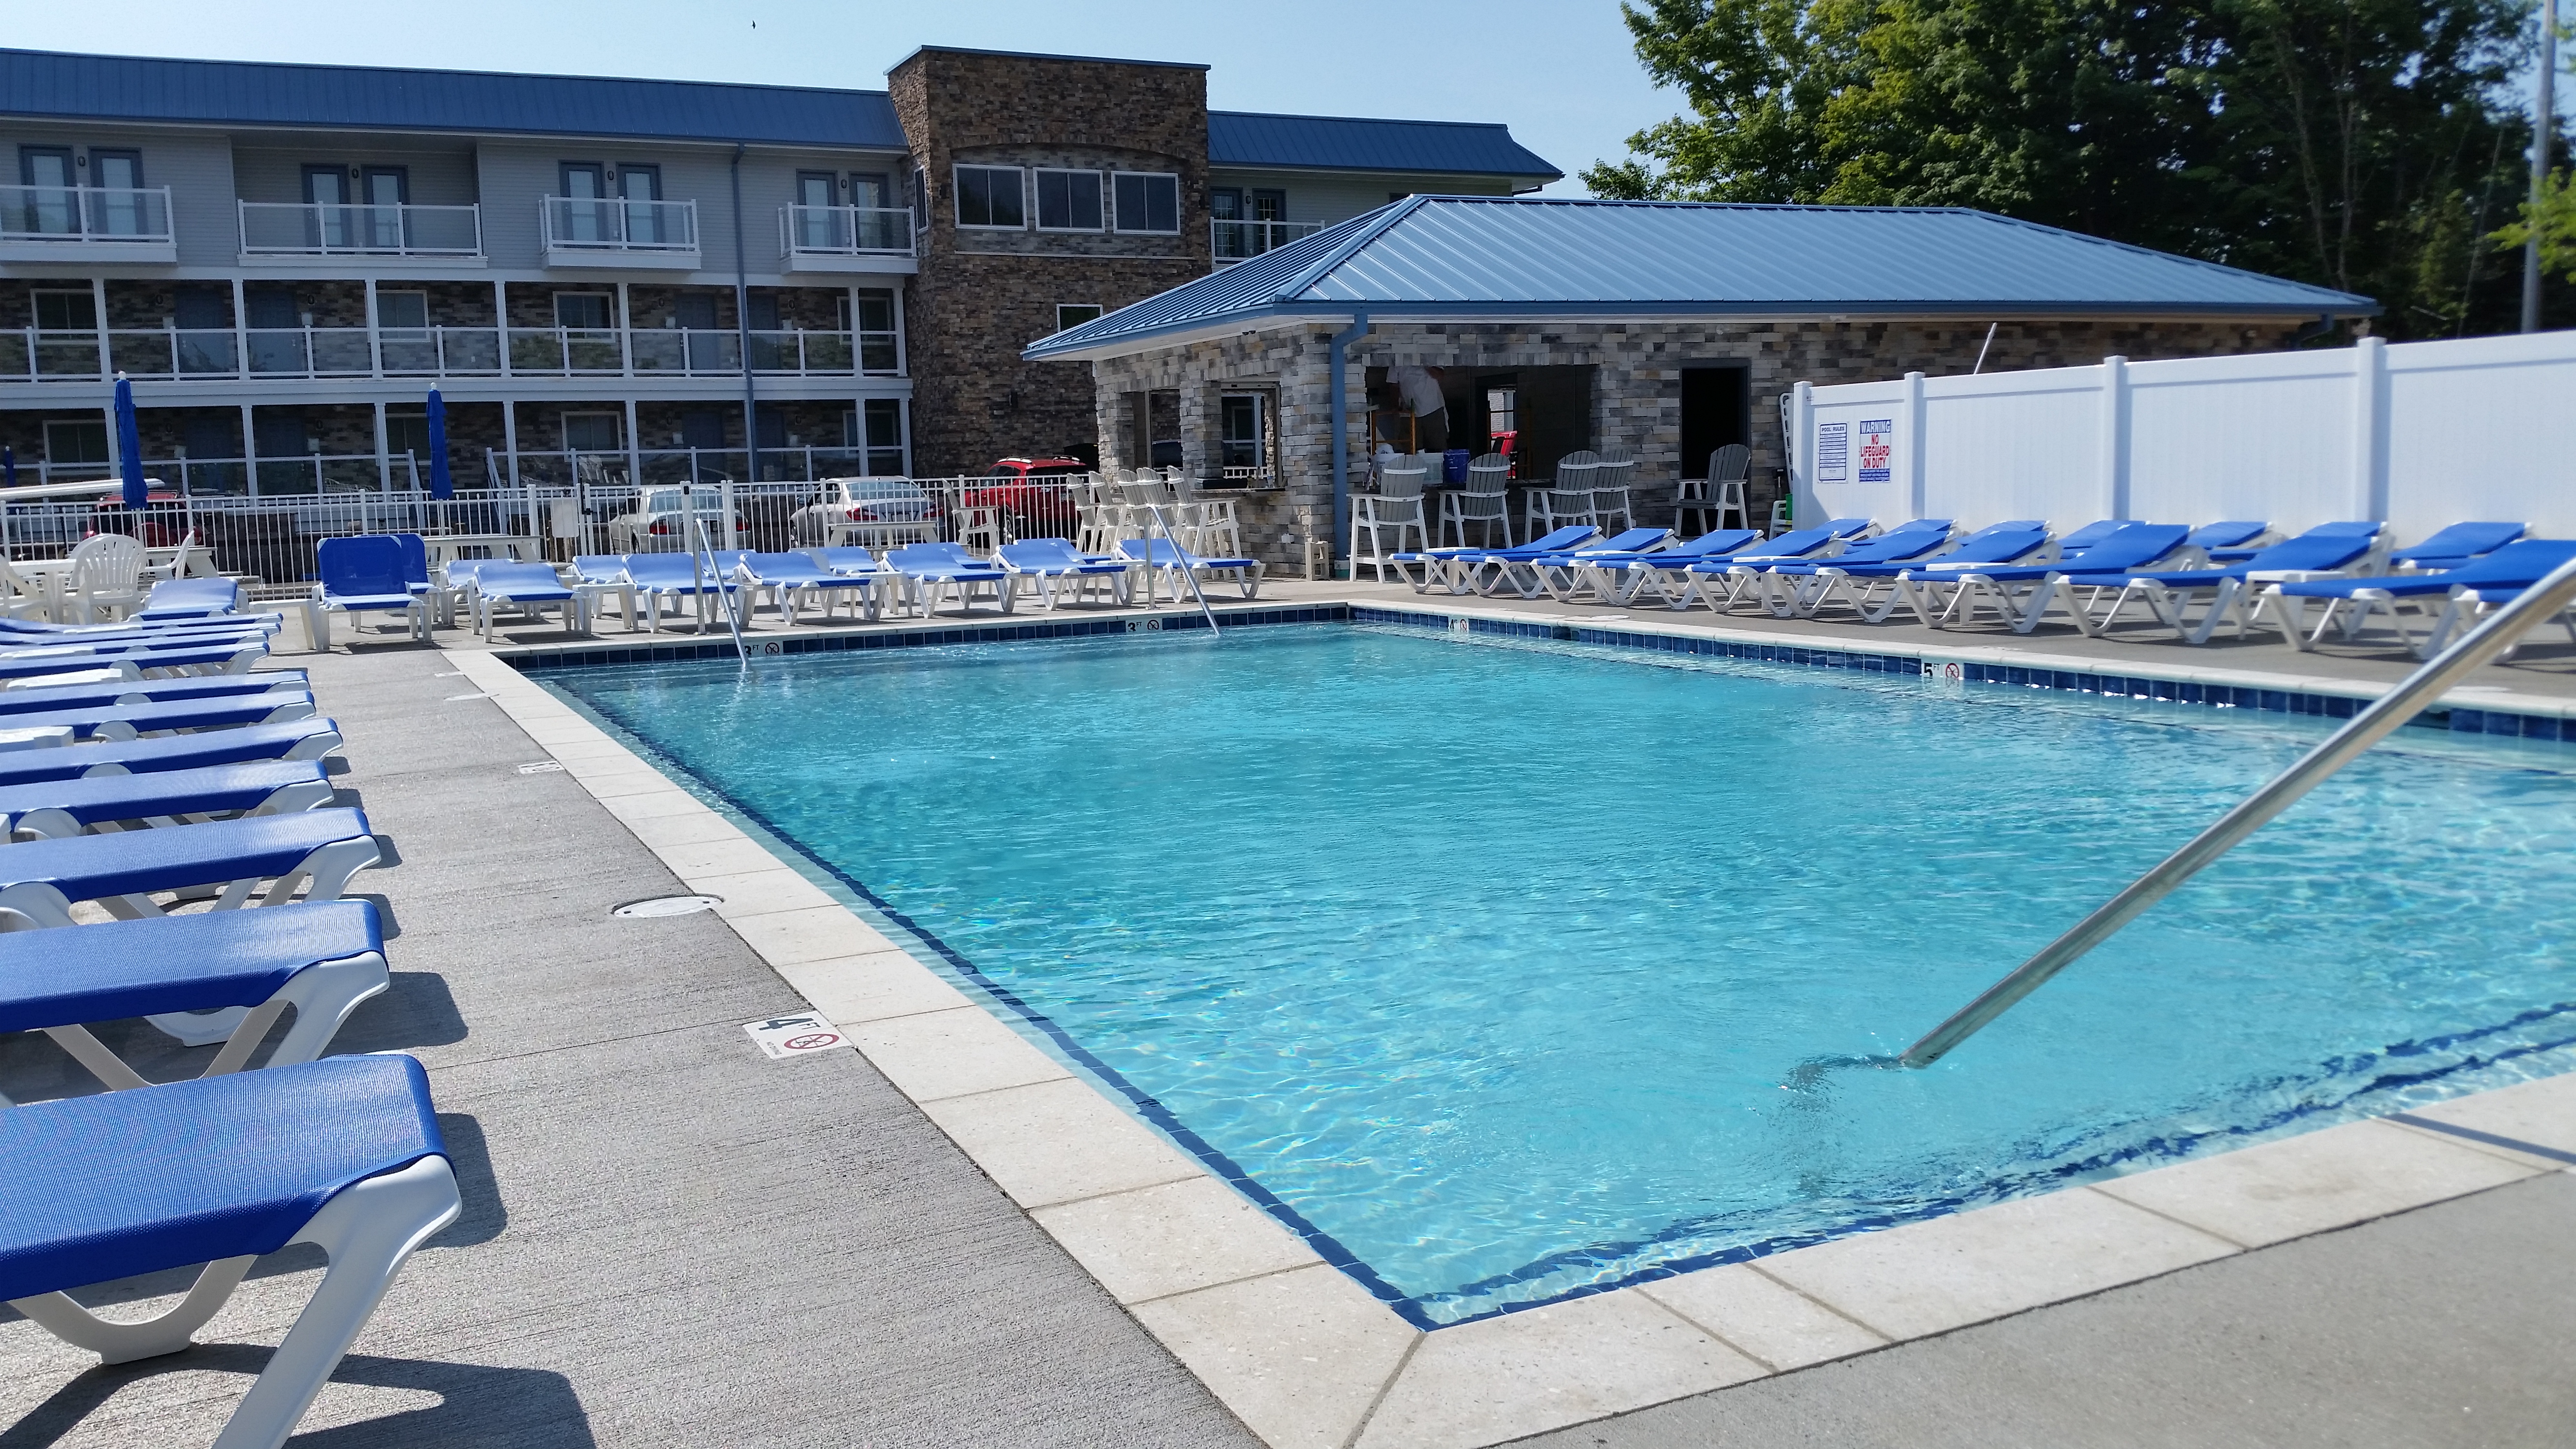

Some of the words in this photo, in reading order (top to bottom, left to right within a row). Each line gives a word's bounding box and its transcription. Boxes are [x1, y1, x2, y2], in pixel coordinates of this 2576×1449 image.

[1861, 420, 1890, 434] WARNING
[1871, 434, 1879, 445] NO
[1861, 445, 1889, 457] LIFEGUARD
[1863, 457, 1870, 468] ON
[1872, 457, 1886, 468] DUTY
[1127, 622, 1136, 631] 3
[1924, 662, 1933, 676] 5
[758, 1018, 814, 1030] 4
